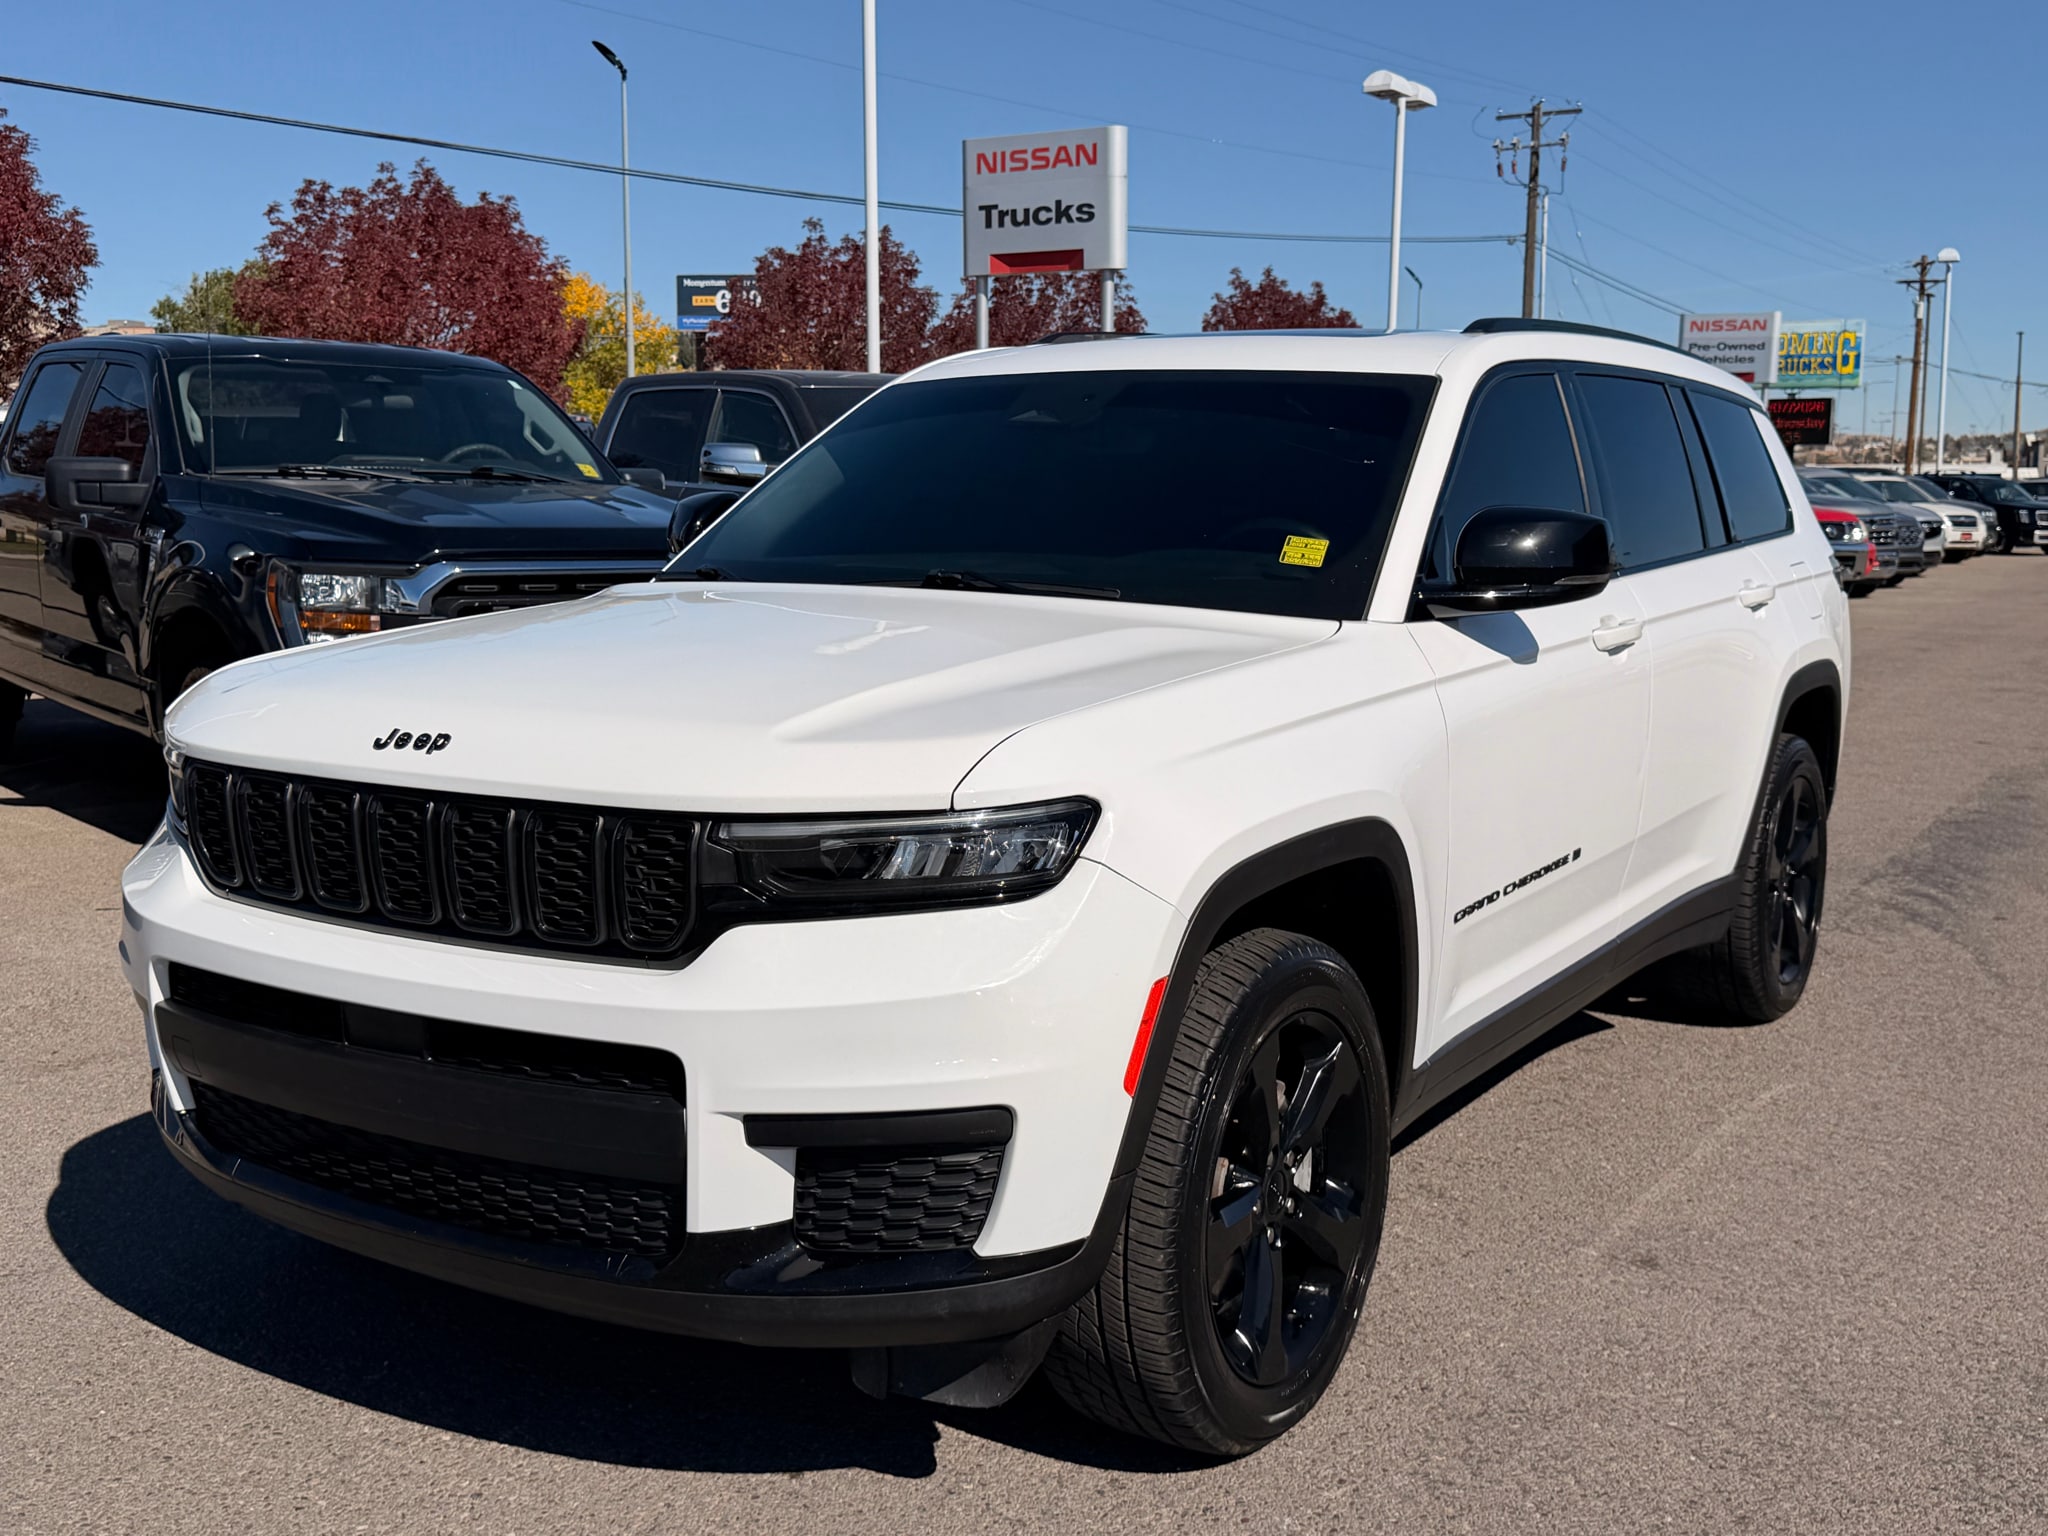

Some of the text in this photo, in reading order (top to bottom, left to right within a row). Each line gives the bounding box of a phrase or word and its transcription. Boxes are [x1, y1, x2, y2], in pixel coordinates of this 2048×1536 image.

[976, 142, 1098, 175] NISSAN
[978, 199, 1096, 229] Trucks
[1689, 319, 1768, 333] NISSAN
[1688, 342, 1766, 352] Pre-Owned
[1702, 355, 1756, 365] ehicles
[1778, 357, 1833, 376] RUCKS
[372, 727, 452, 755] Jeep
[1453, 853, 1571, 924] GRAND CHEROKEE
